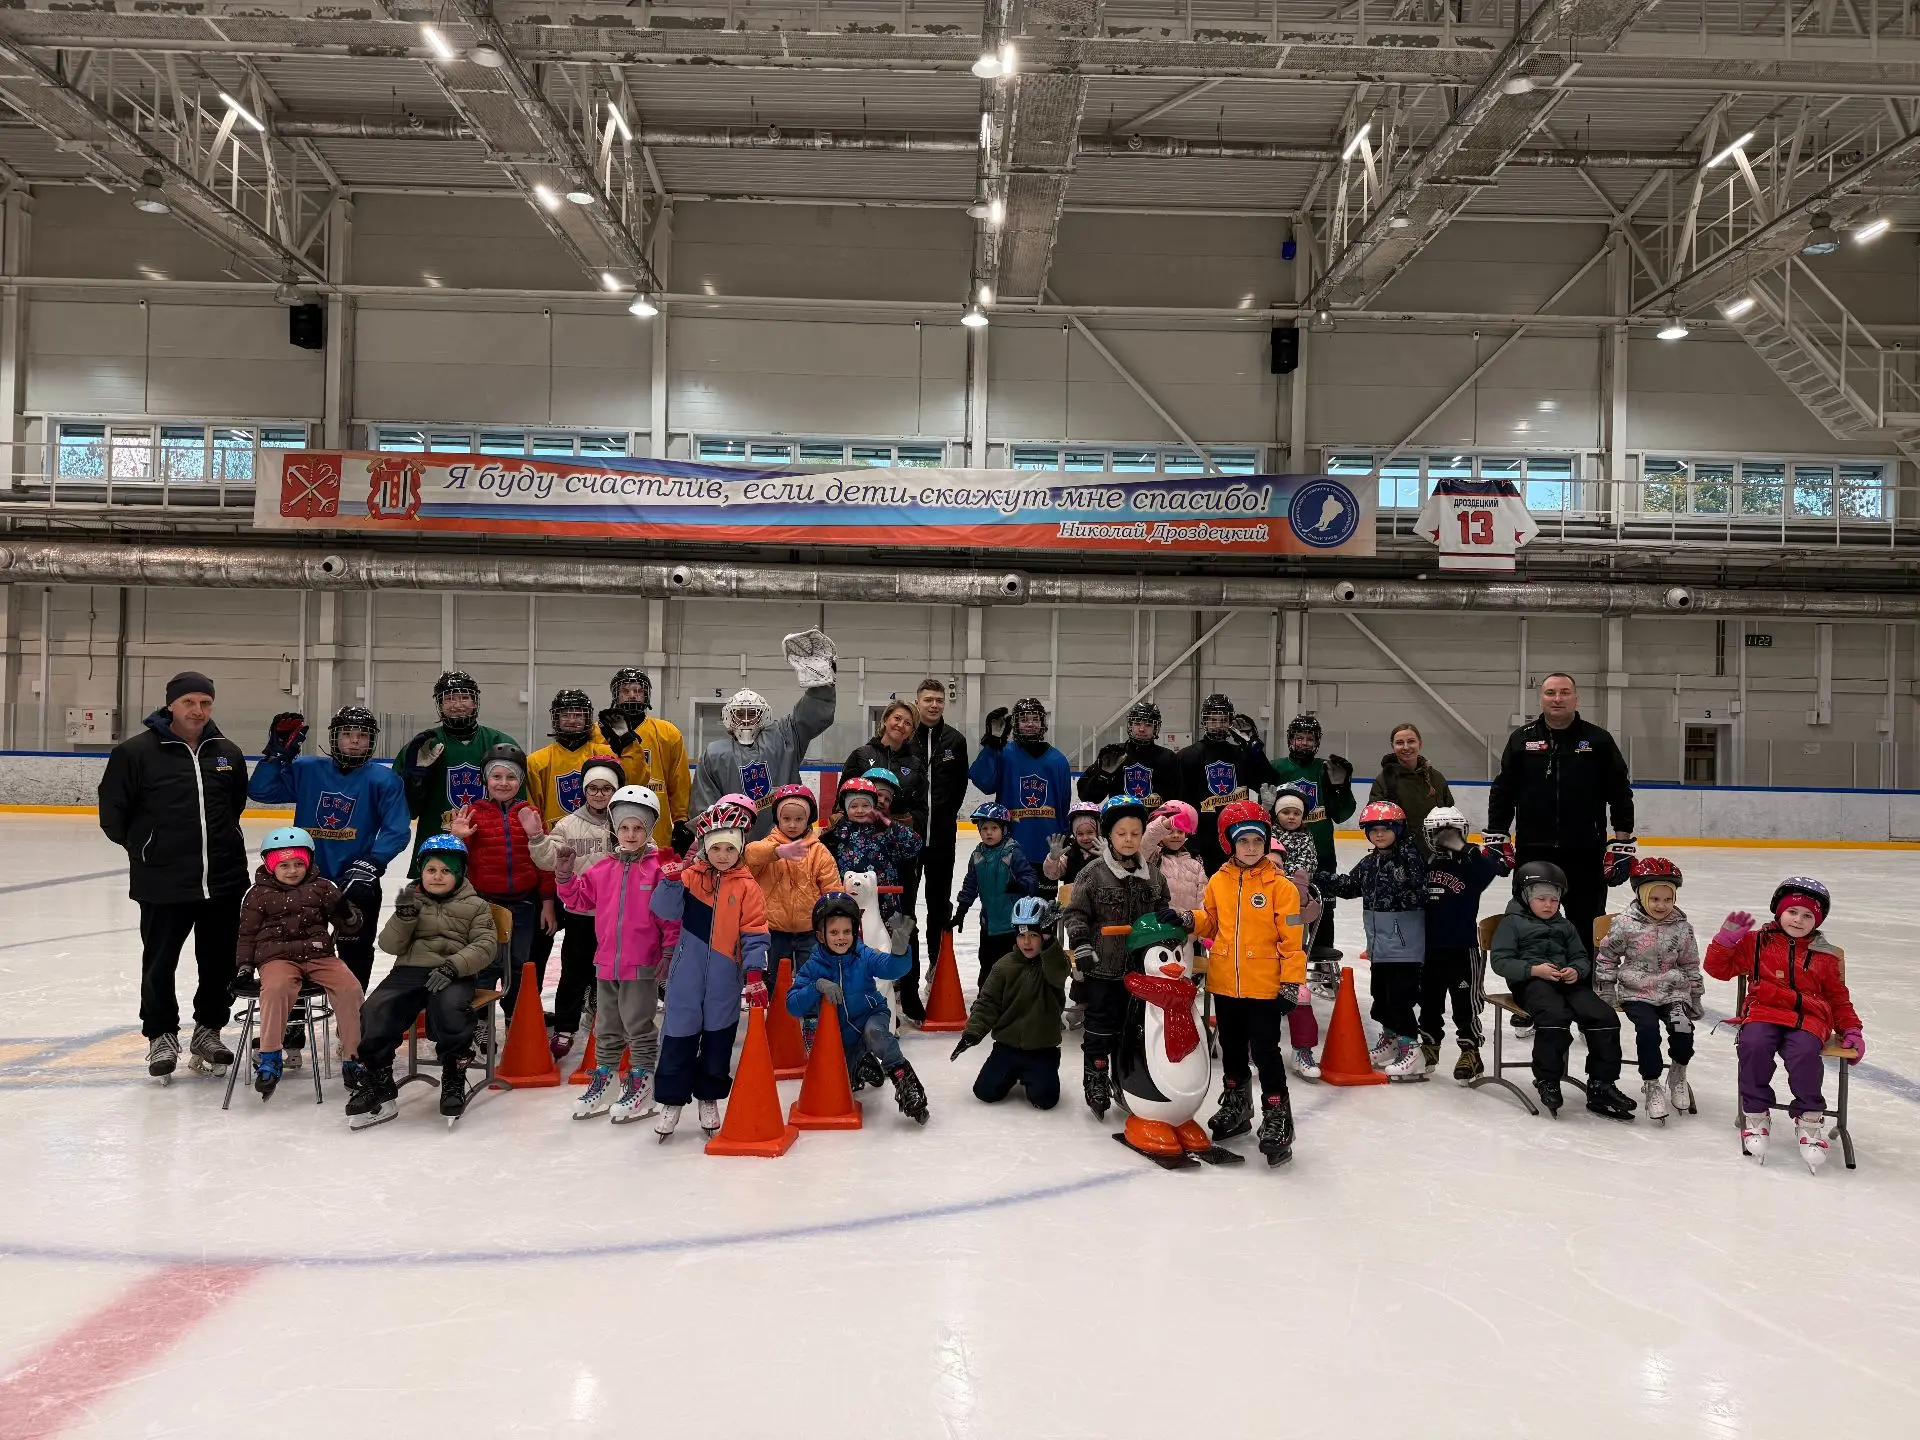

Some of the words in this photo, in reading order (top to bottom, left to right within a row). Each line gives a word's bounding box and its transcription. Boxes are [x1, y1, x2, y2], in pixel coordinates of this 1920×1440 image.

[443, 466, 472, 489] Я
[478, 466, 555, 498] буду
[565, 475, 730, 504] счастлив,
[743, 482, 815, 501] если
[825, 477, 909, 503] дети
[919, 487, 1050, 513] скажут
[1057, 491, 1123, 509] мне
[1132, 486, 1270, 511] спасибо!
[1453, 497, 1499, 509] ДРОЗДЕЦКИЙ
[1060, 522, 1146, 539] Николай
[1148, 523, 1267, 543] Дроздецкий
[1457, 510, 1494, 545] 13
[715, 689, 722, 698] 5
[889, 692, 896, 700] 4
[1704, 710, 1712, 719] 3
[1427, 870, 1466, 894] LETIC
